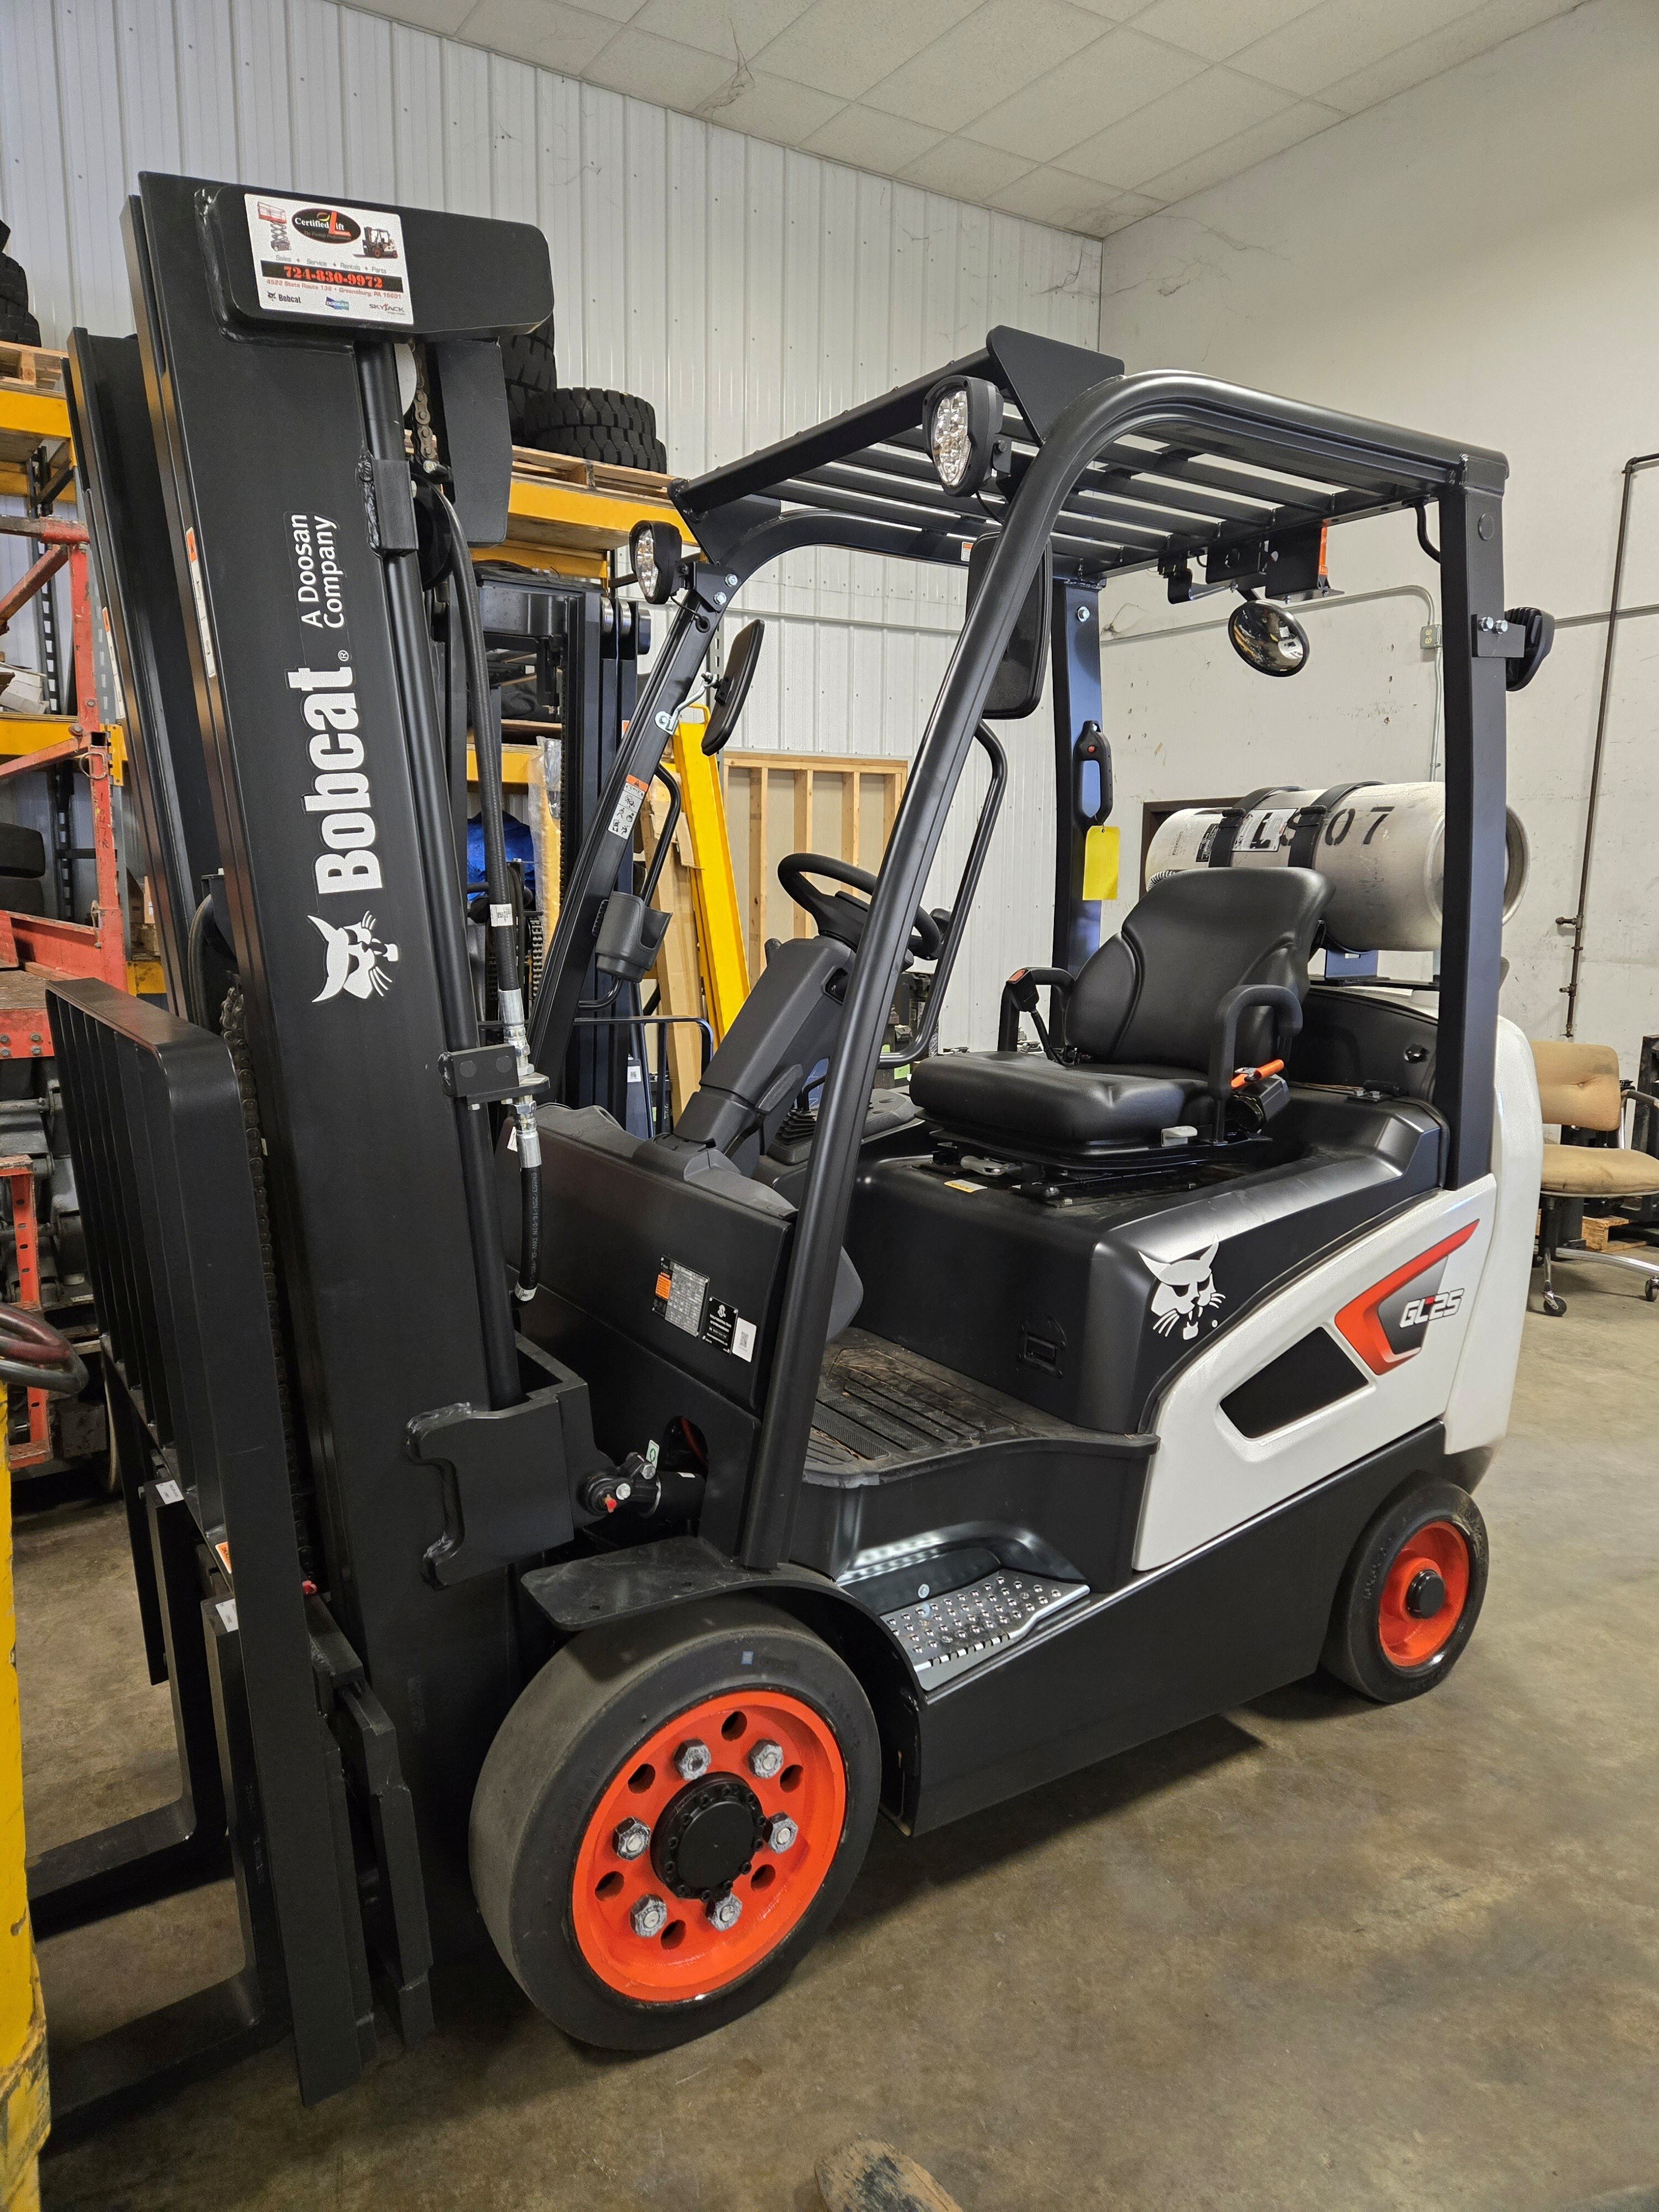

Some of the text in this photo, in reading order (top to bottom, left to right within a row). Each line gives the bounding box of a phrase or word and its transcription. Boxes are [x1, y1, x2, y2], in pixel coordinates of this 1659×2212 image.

[294, 217, 330, 228] Certified
[284, 265, 383, 289] 724-830-9972
[306, 258, 327, 267] Service
[340, 262, 361, 270] Rentals
[278, 294, 301, 304] Bobcat
[291, 514, 324, 628] A Doosan
[314, 515, 345, 628] Company
[287, 666, 383, 894] Bobcat
[1399, 1287, 1465, 1328] GL25
